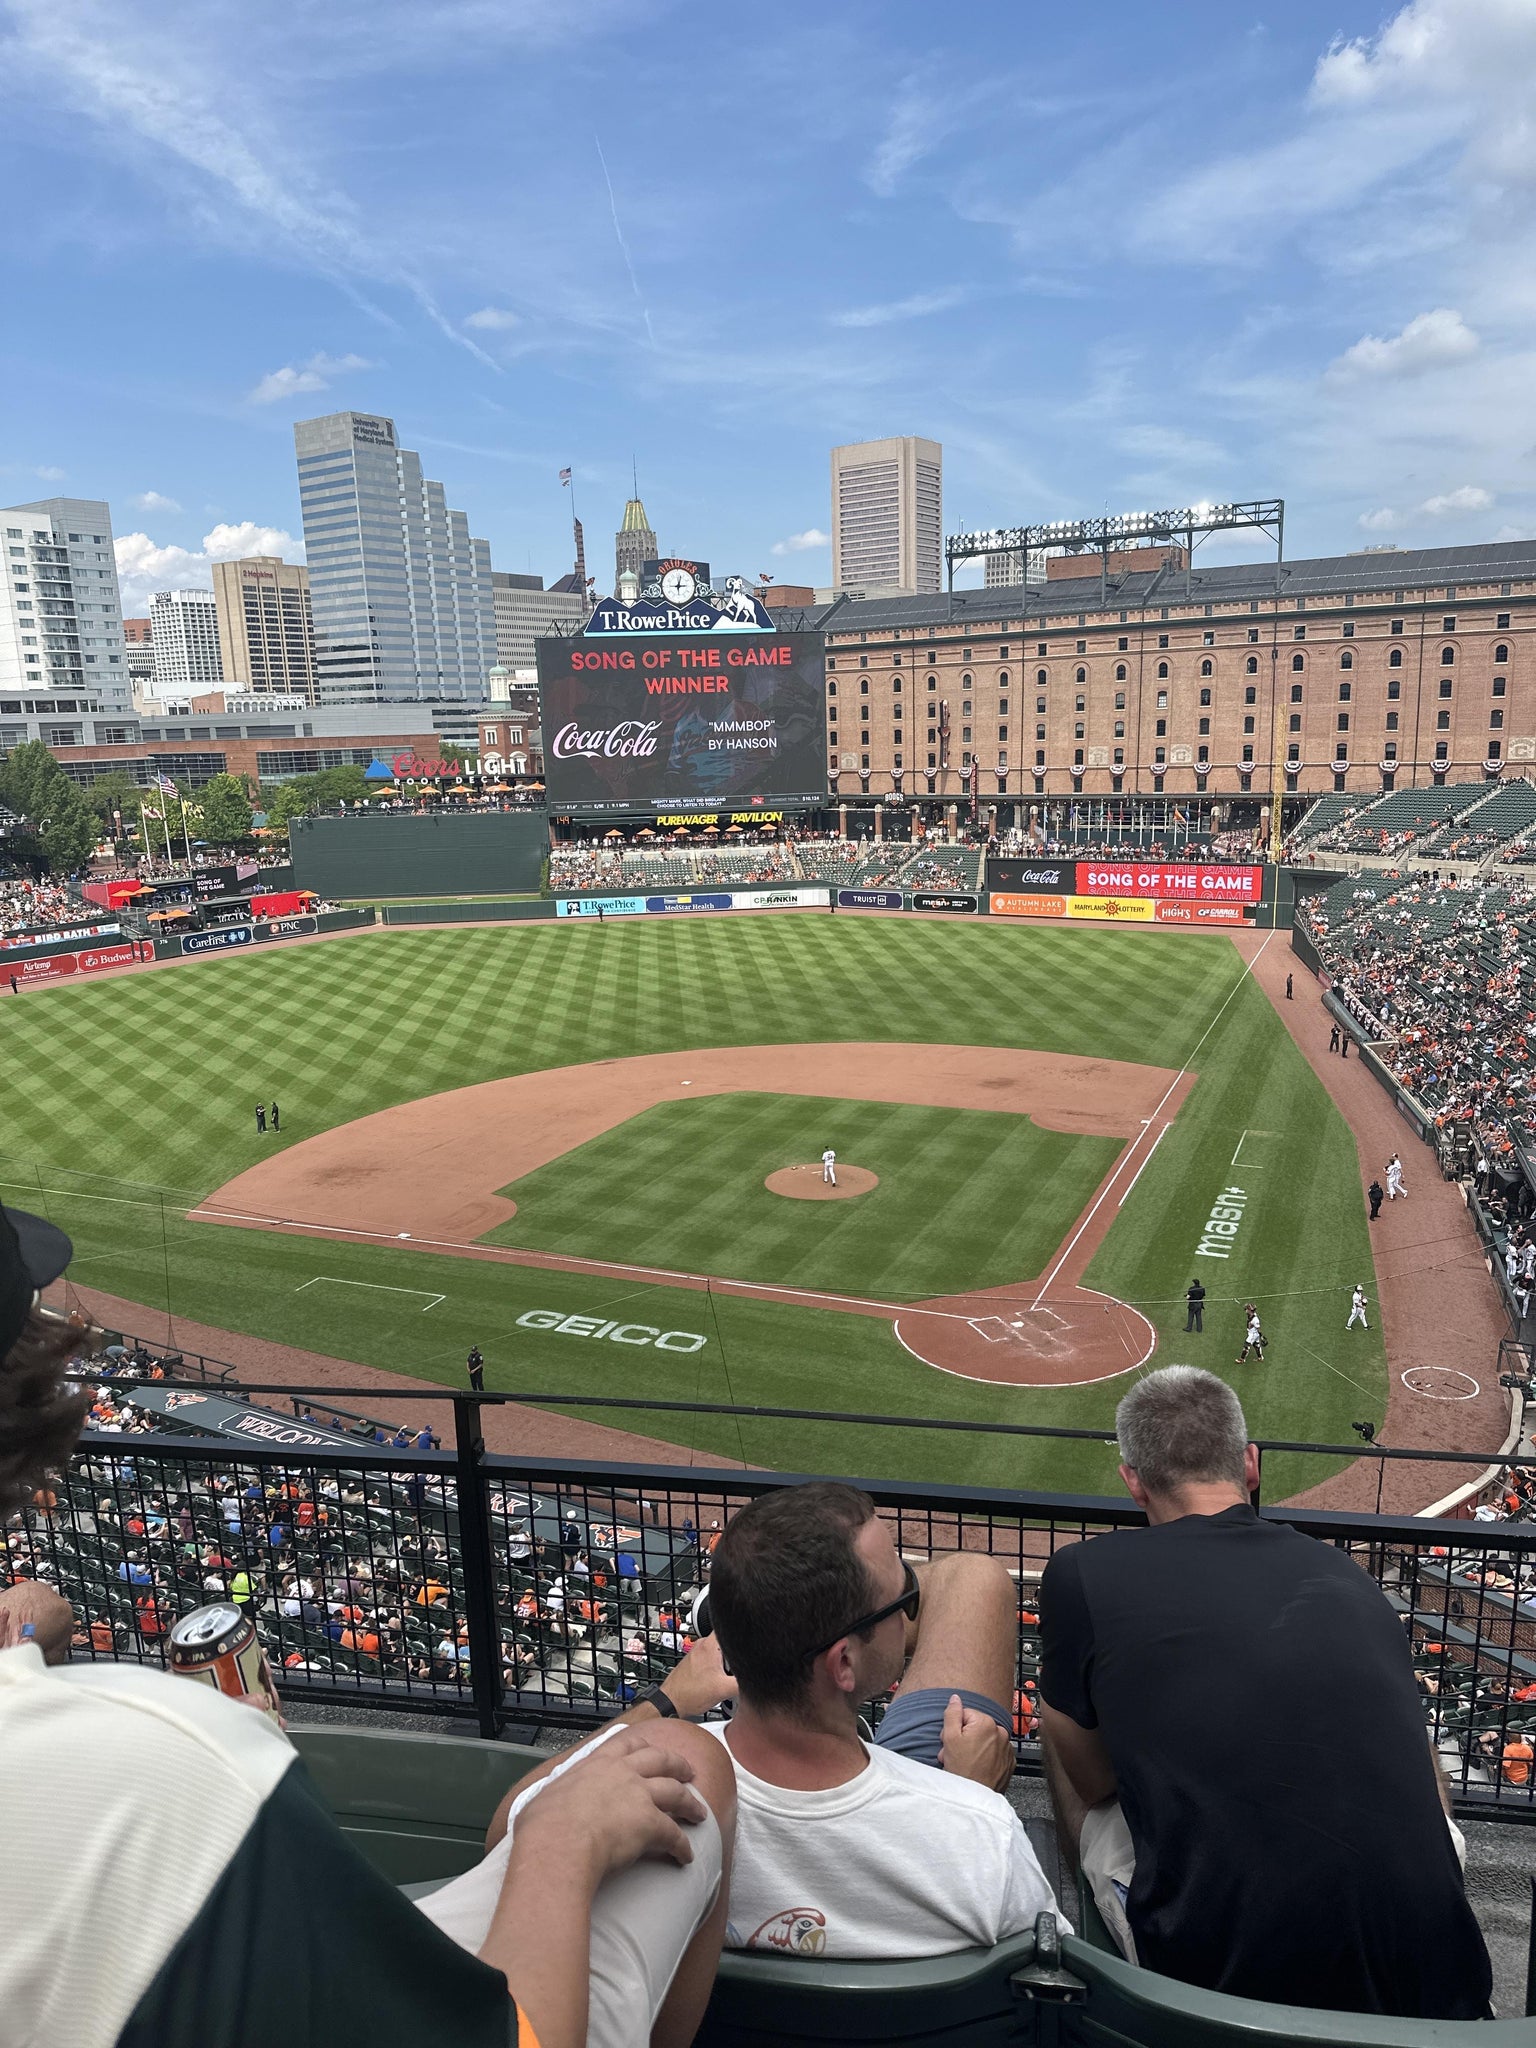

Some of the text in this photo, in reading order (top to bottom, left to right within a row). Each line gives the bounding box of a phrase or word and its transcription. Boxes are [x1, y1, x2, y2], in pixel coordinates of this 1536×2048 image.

[353, 433, 375, 444] Medical
[657, 559, 698, 575] ORIOLES
[571, 646, 793, 671] SONG OF THE GAME
[644, 675, 729, 695] WINNER
[552, 720, 664, 759] Coca-Cola
[708, 738, 778, 750] BY HANSON
[391, 752, 528, 778] Coors LIGHT
[394, 775, 501, 786] ROOF DECK
[657, 811, 783, 826] PUREWAGER PAVILION
[1022, 869, 1253, 890] Coca-Cola SONG OF THE GAME
[664, 902, 715, 911] MedStar Health
[853, 895, 877, 903] TRUIST
[1162, 907, 1191, 919] HIGH'S
[280, 921, 300, 932] PNC
[34, 932, 61, 944] BIRD
[63, 929, 91, 939] BATH
[189, 934, 228, 949] CareFirst
[100, 951, 149, 964] Budwesr
[23, 961, 51, 972] Airtemp
[515, 1310, 708, 1353] GEICO
[236, 1415, 343, 1446] WELCO
